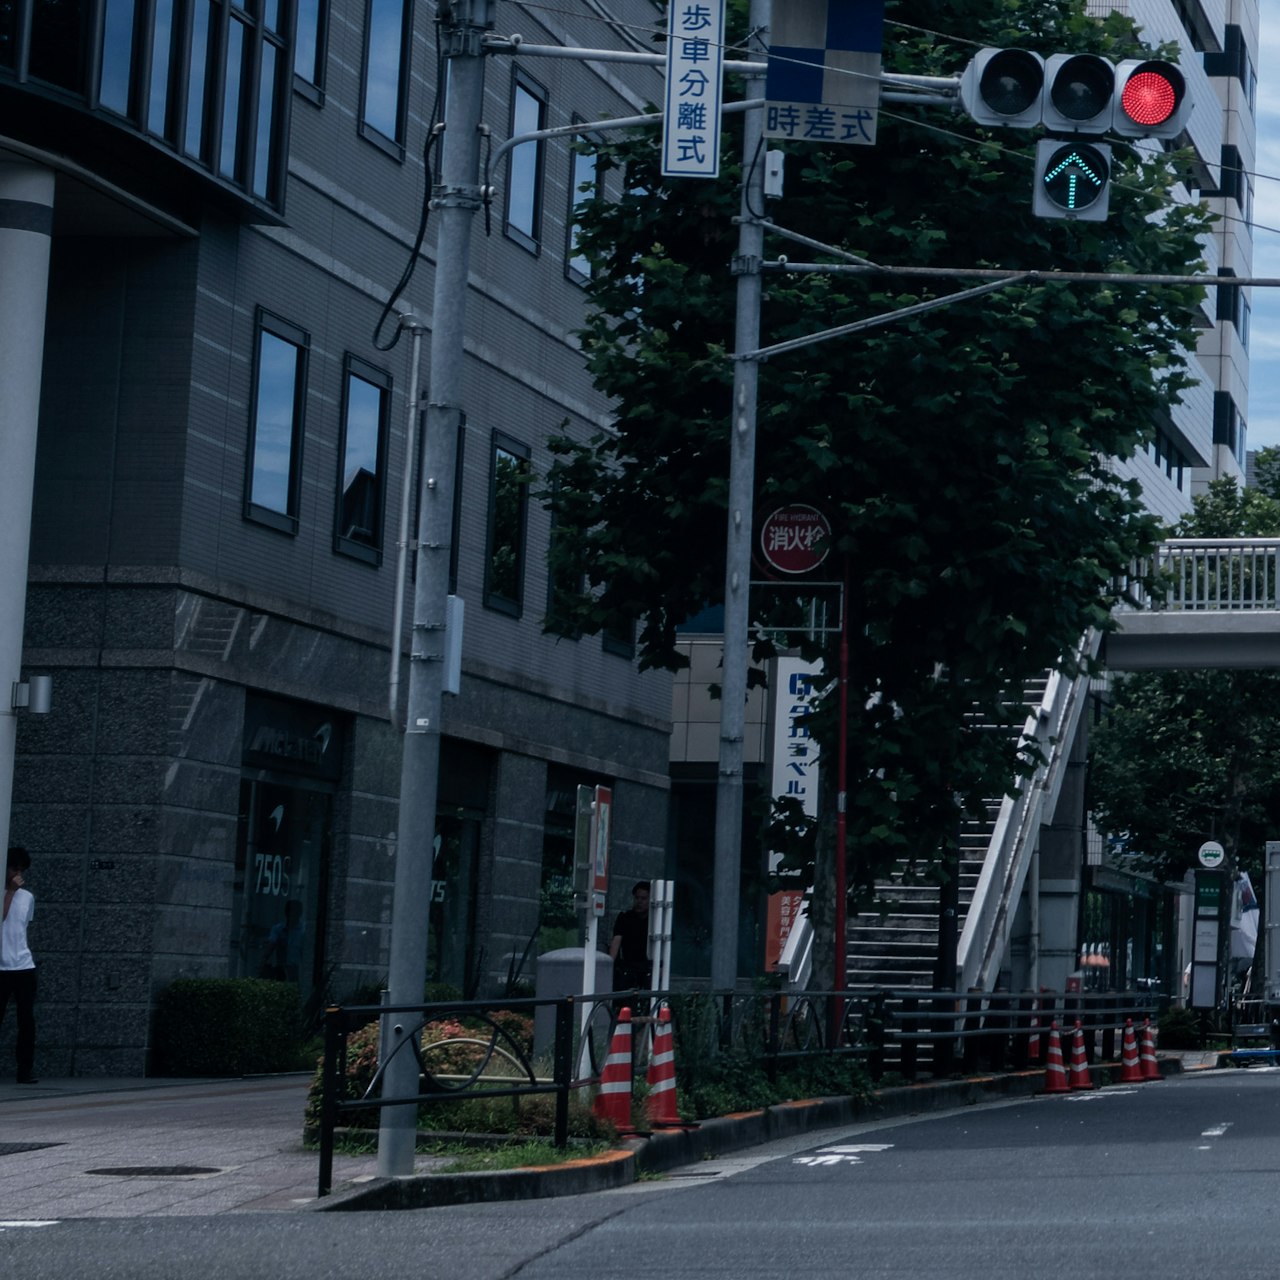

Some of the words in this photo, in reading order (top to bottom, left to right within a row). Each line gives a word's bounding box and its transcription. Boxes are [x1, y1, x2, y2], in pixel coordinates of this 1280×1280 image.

[677, 4, 712, 165] 歩車分離式
[767, 104, 874, 143] 時差式
[769, 525, 825, 551] 消火栓
[255, 853, 291, 896] 750S
